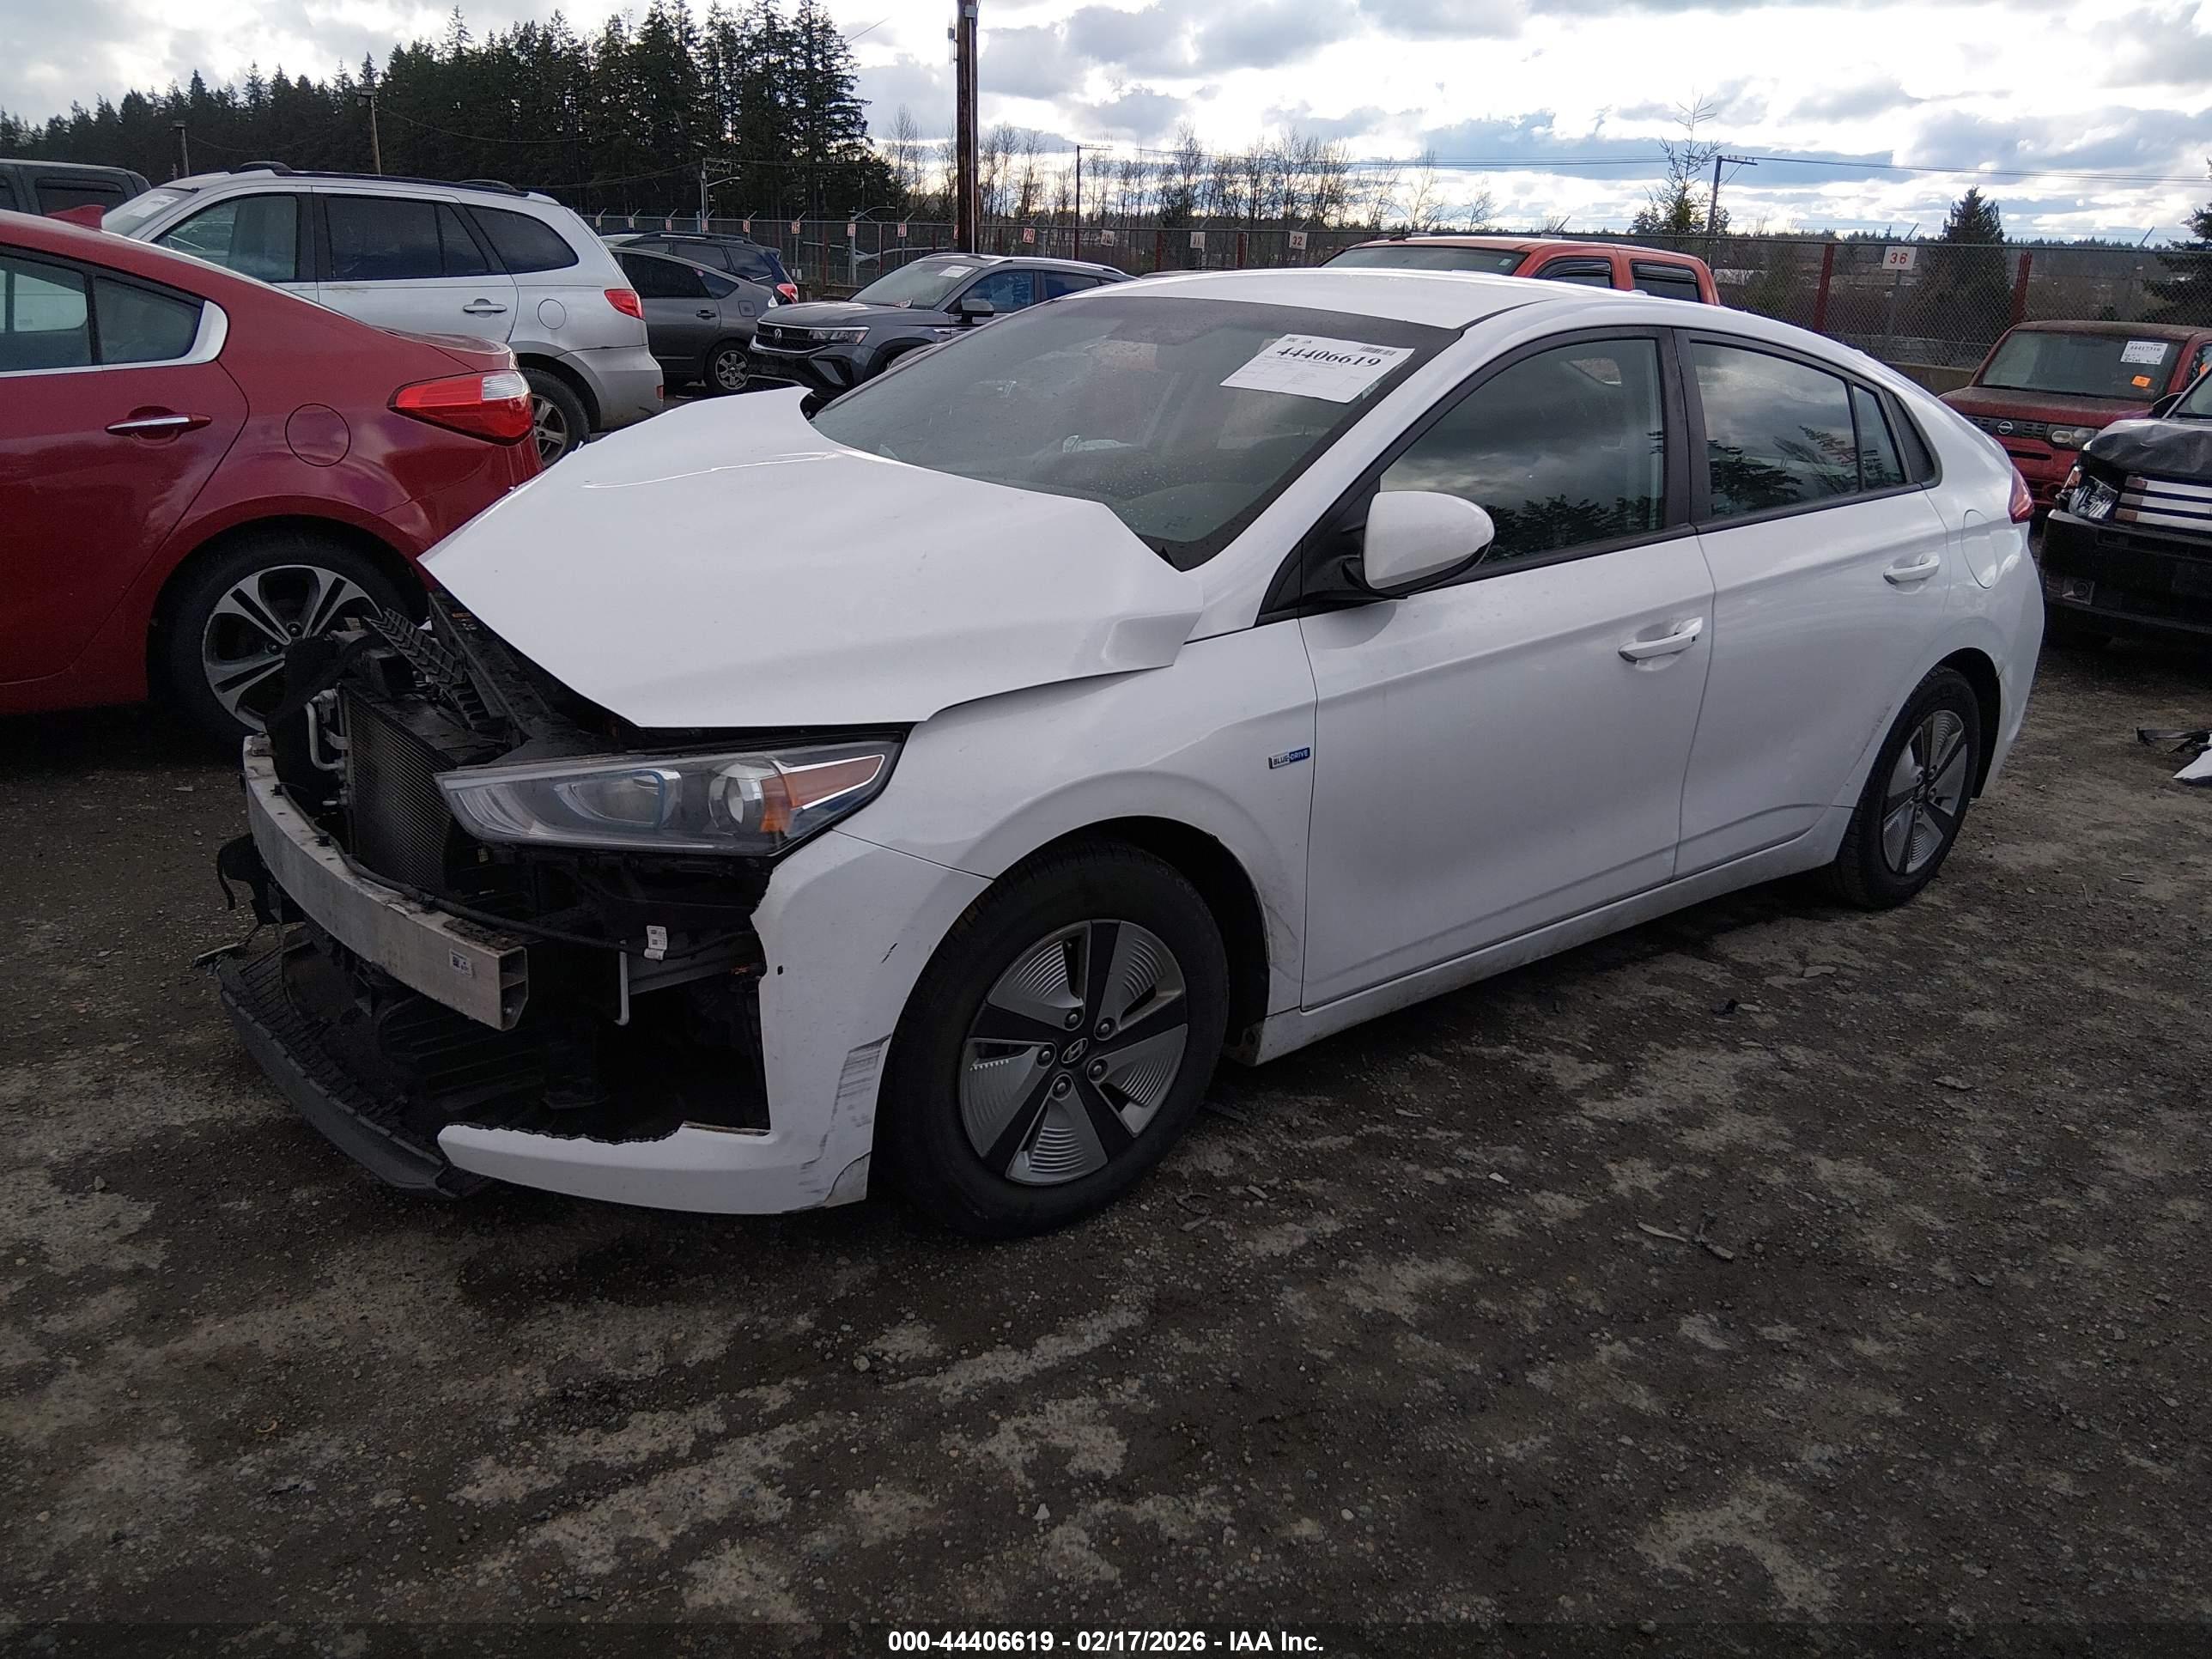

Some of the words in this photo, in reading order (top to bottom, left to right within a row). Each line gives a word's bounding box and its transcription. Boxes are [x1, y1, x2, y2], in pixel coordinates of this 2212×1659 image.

[744, 221, 750, 232] 24
[792, 222, 799, 233] 25
[898, 224, 906, 236] 27
[1024, 229, 1034, 242] 29
[1292, 235, 1303, 246] 32
[1889, 252, 1908, 264] 36
[1276, 346, 1382, 368] 44406619
